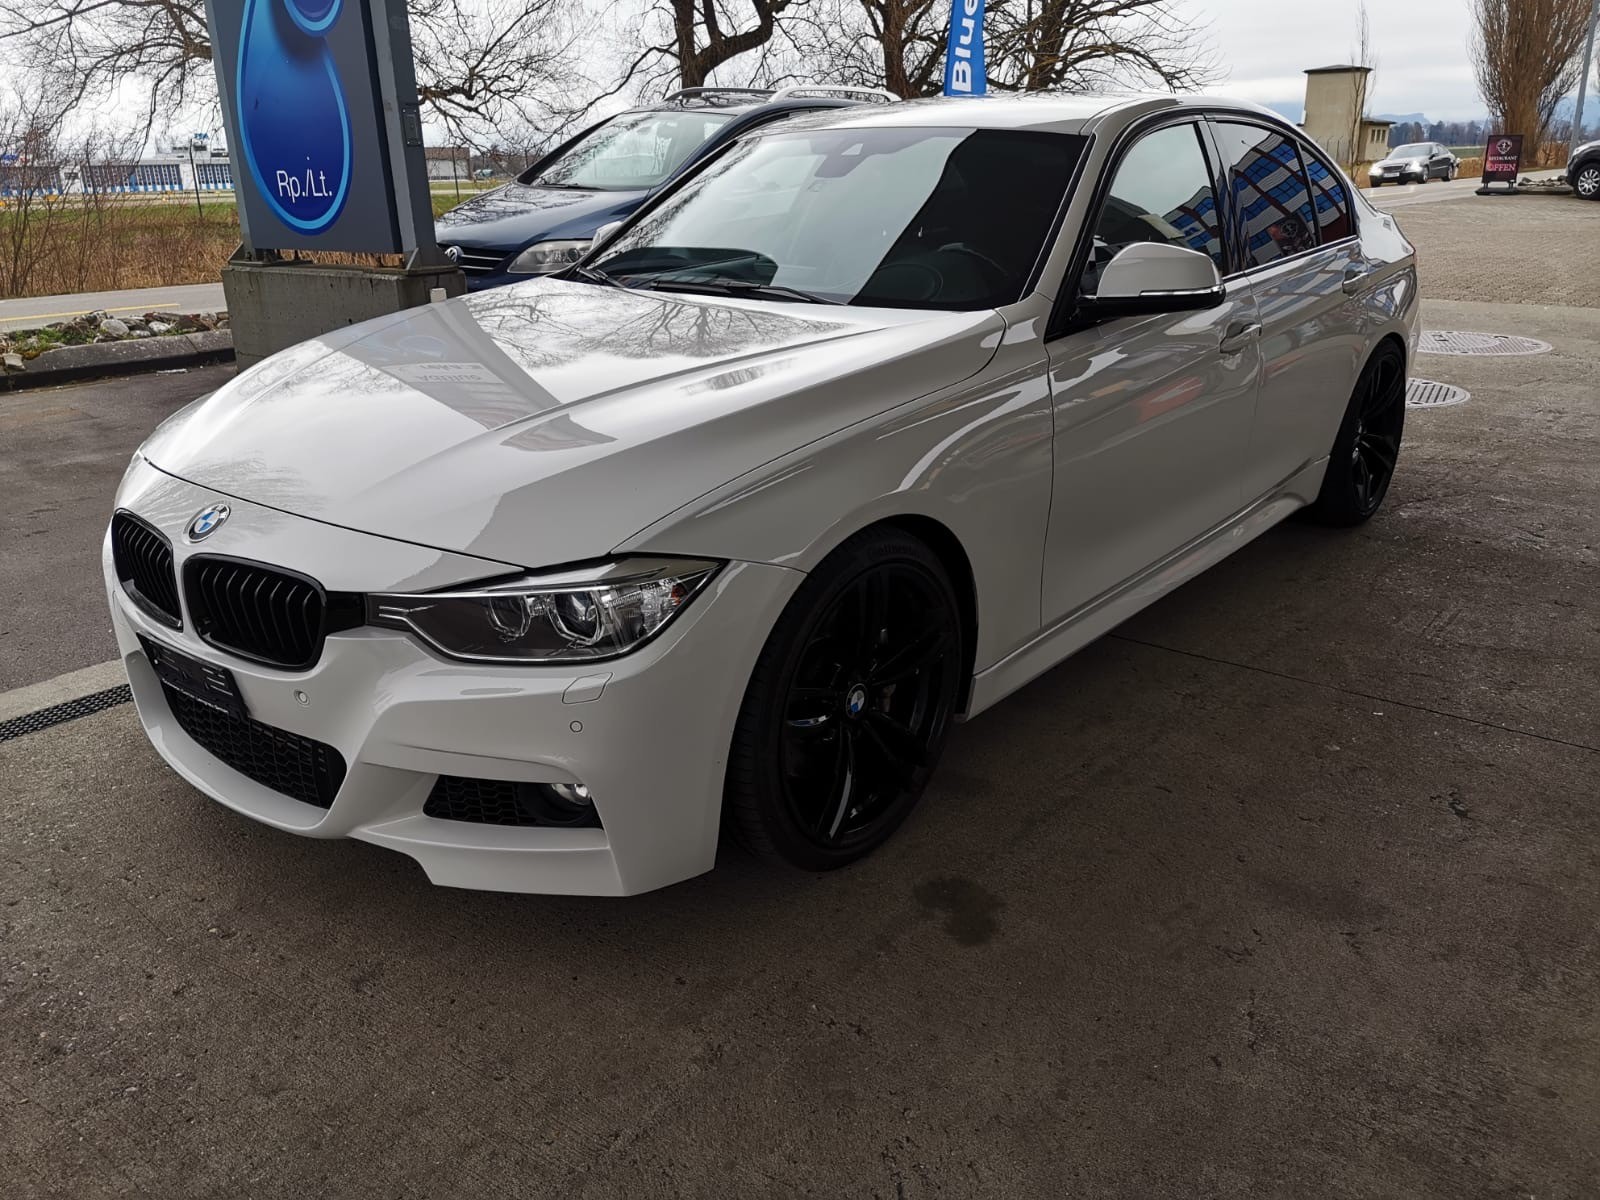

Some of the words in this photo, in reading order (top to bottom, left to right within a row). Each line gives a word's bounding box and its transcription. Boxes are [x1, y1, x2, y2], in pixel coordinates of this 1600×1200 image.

[952, 0, 978, 92] Blue
[1486, 163, 1516, 171] OFFEN
[276, 168, 333, 203] Rp./Lt.
